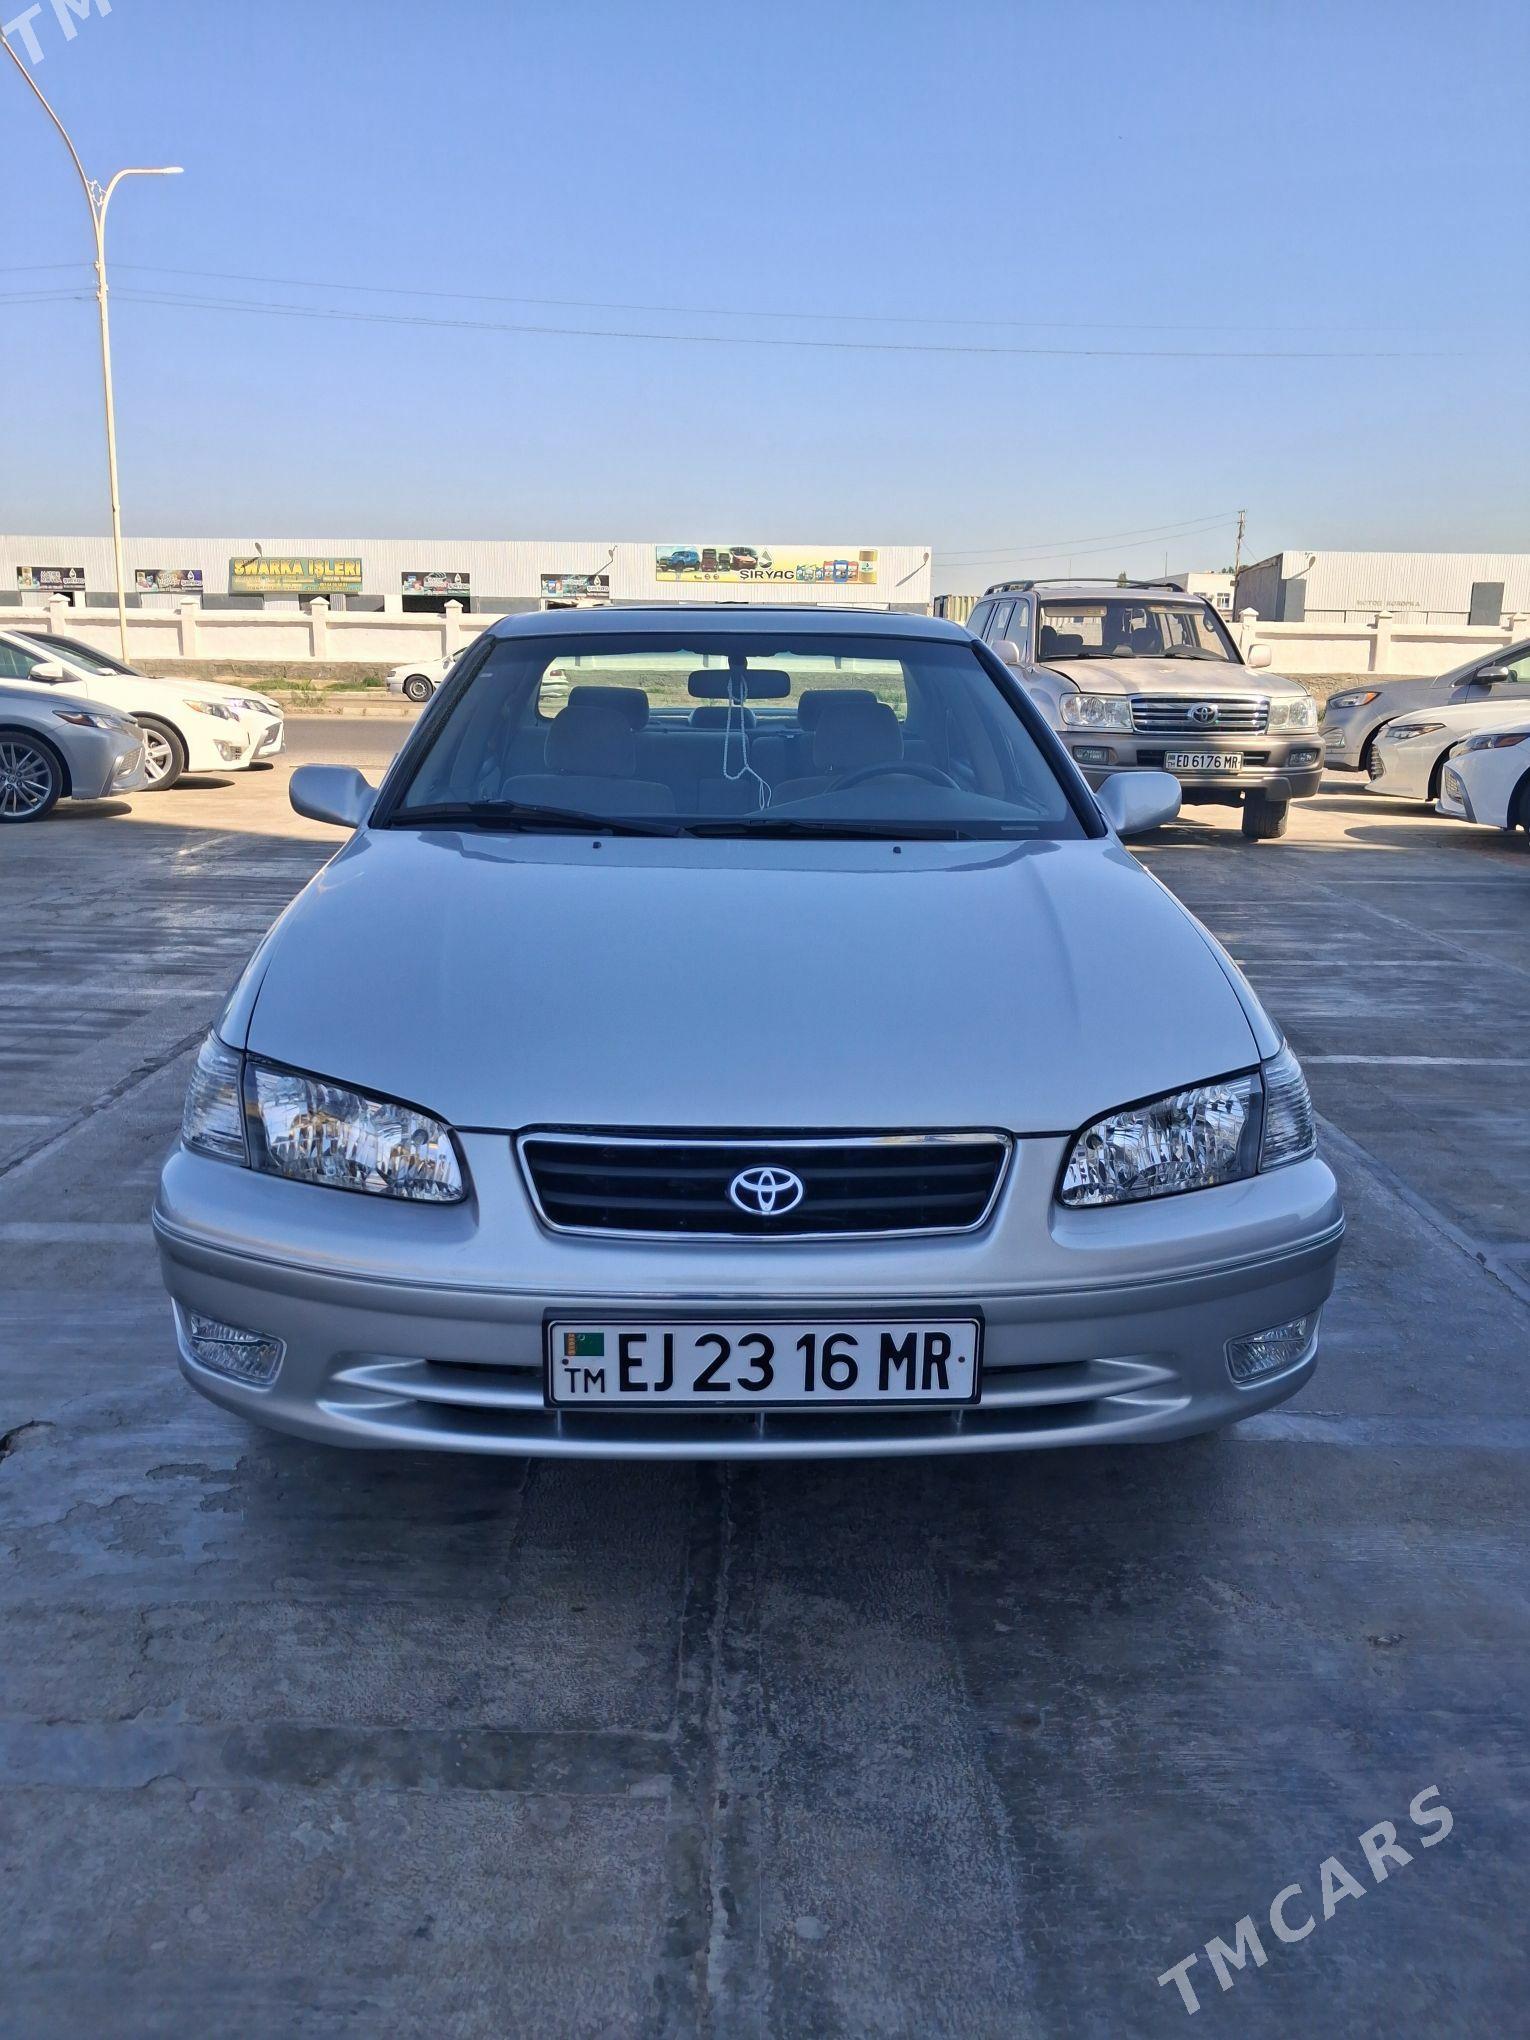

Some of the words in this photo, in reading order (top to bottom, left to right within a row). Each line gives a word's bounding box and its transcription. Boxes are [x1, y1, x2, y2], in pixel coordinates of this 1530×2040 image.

[233, 559, 304, 576] SWARKA
[1176, 754, 1189, 767] ED
[1192, 755, 1222, 768] 6176
[1223, 756, 1238, 769] MR
[618, 1332, 674, 1392] EJ
[692, 1332, 775, 1392] 23
[796, 1332, 859, 1392] 16
[878, 1332, 951, 1391] MR
[563, 1367, 606, 1394] TM
